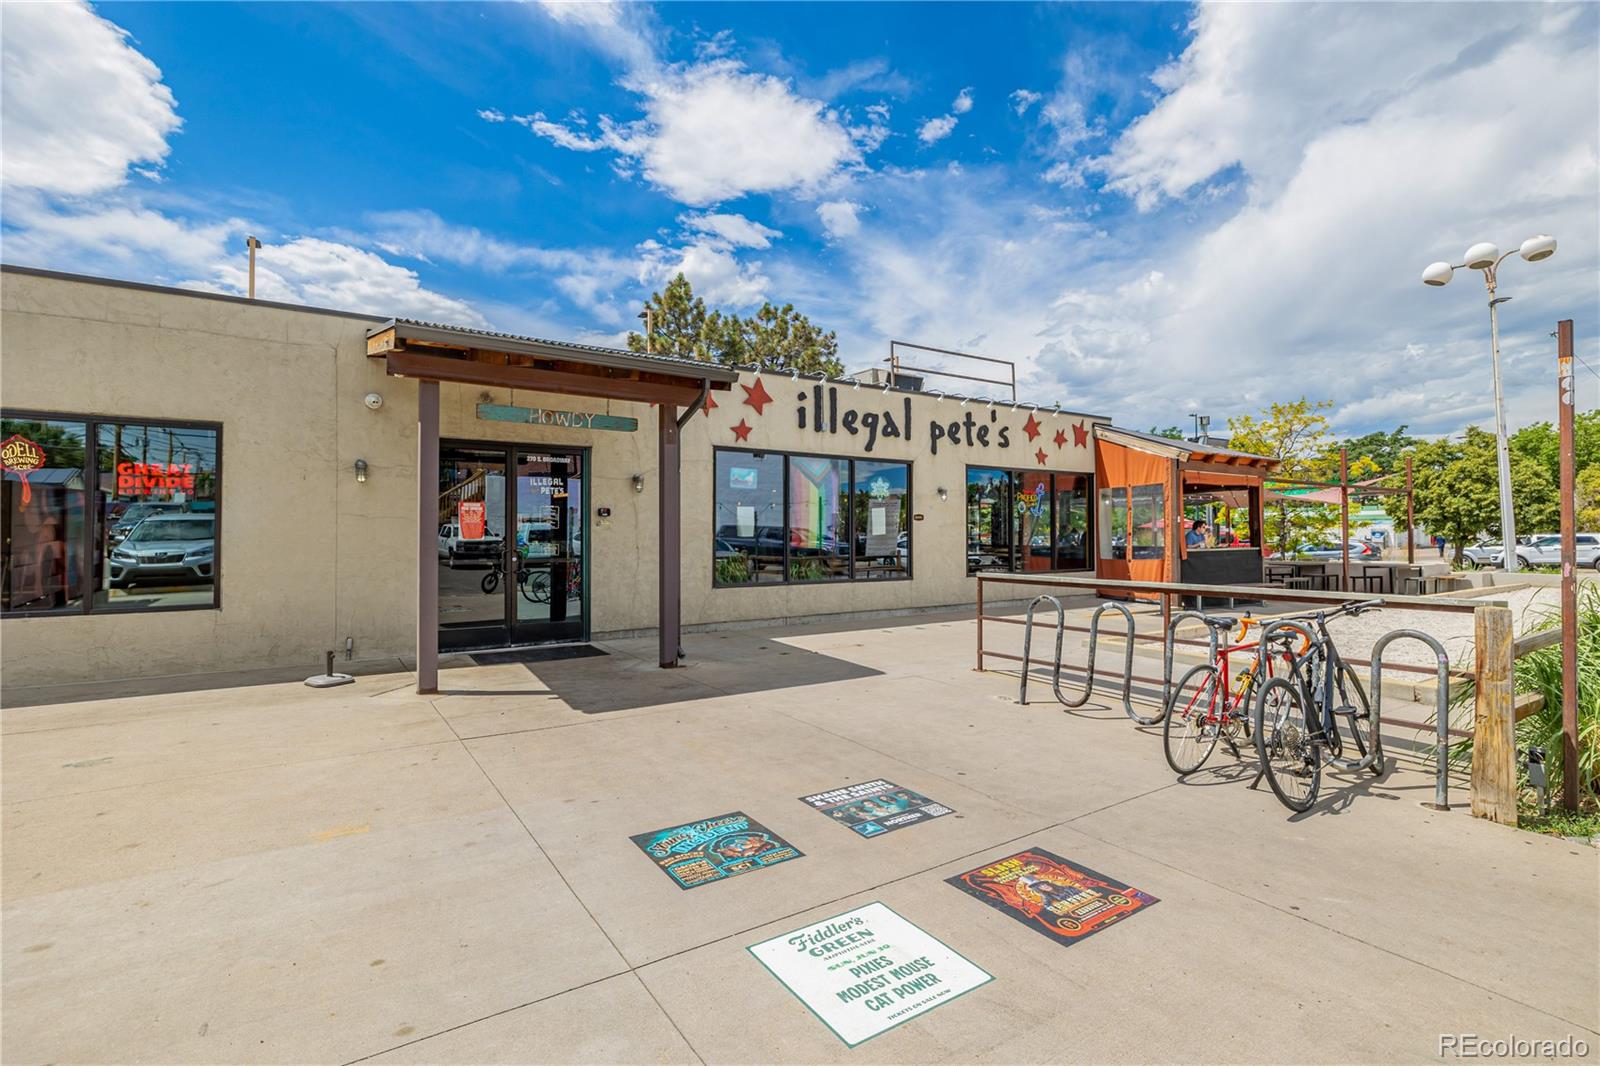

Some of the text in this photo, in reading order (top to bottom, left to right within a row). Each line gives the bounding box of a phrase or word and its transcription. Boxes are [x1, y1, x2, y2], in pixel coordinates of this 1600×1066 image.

[529, 408, 595, 428] HOWDY
[796, 385, 1009, 455] illegal pete's
[1, 441, 39, 459] ODELL
[3, 456, 39, 466] BREWING
[117, 463, 193, 476] GREAT
[118, 475, 194, 489] DIVIDE
[530, 477, 564, 486] ILLEGAL
[540, 486, 565, 495] PETE'S
[804, 788, 850, 802] SHANE
[847, 779, 887, 792] SMITH
[824, 793, 852, 803] THE
[850, 783, 894, 797] SAINTS
[981, 859, 1023, 877] SLASH
[788, 917, 864, 952] Fiddler's
[808, 928, 874, 957] GREEN
[849, 956, 894, 978] PIXIES
[836, 956, 935, 1003] MODEST MOUSE
[864, 973, 942, 1011] CAT POWER
[887, 1006, 913, 1021] TICKETS
[922, 995, 936, 1004] SALE
